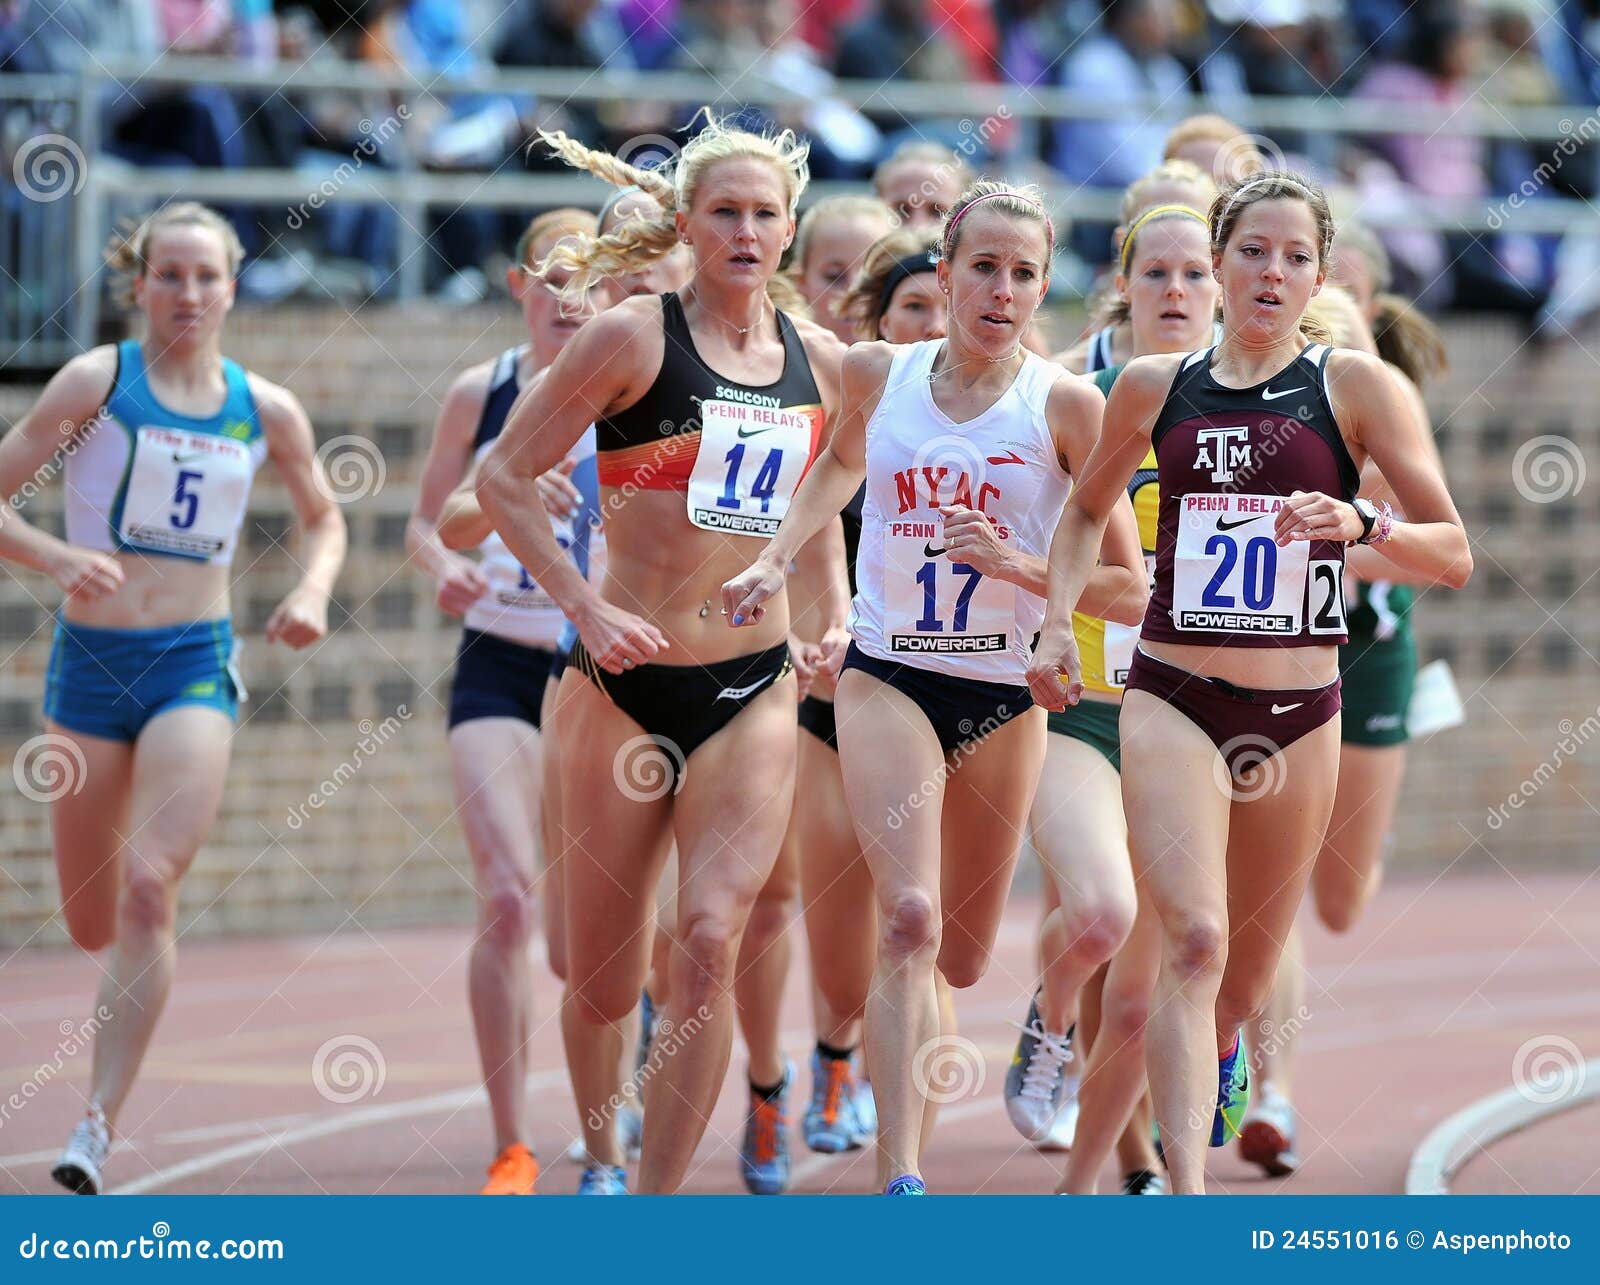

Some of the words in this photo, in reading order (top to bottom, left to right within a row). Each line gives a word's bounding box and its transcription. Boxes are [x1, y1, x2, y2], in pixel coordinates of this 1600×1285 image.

[709, 404, 746, 420] PENN
[753, 409, 804, 429] RELAYS
[715, 385, 780, 409] saucony
[170, 470, 203, 530] 5
[716, 443, 783, 513] 14
[894, 466, 1001, 524] NYAC
[1187, 496, 1229, 512] PENN
[1237, 497, 1284, 513] RELA
[697, 510, 779, 533] POWERADE
[892, 523, 935, 538] PENN
[916, 562, 983, 632] 17
[1201, 535, 1277, 610] 20
[1314, 564, 1348, 629] 2
